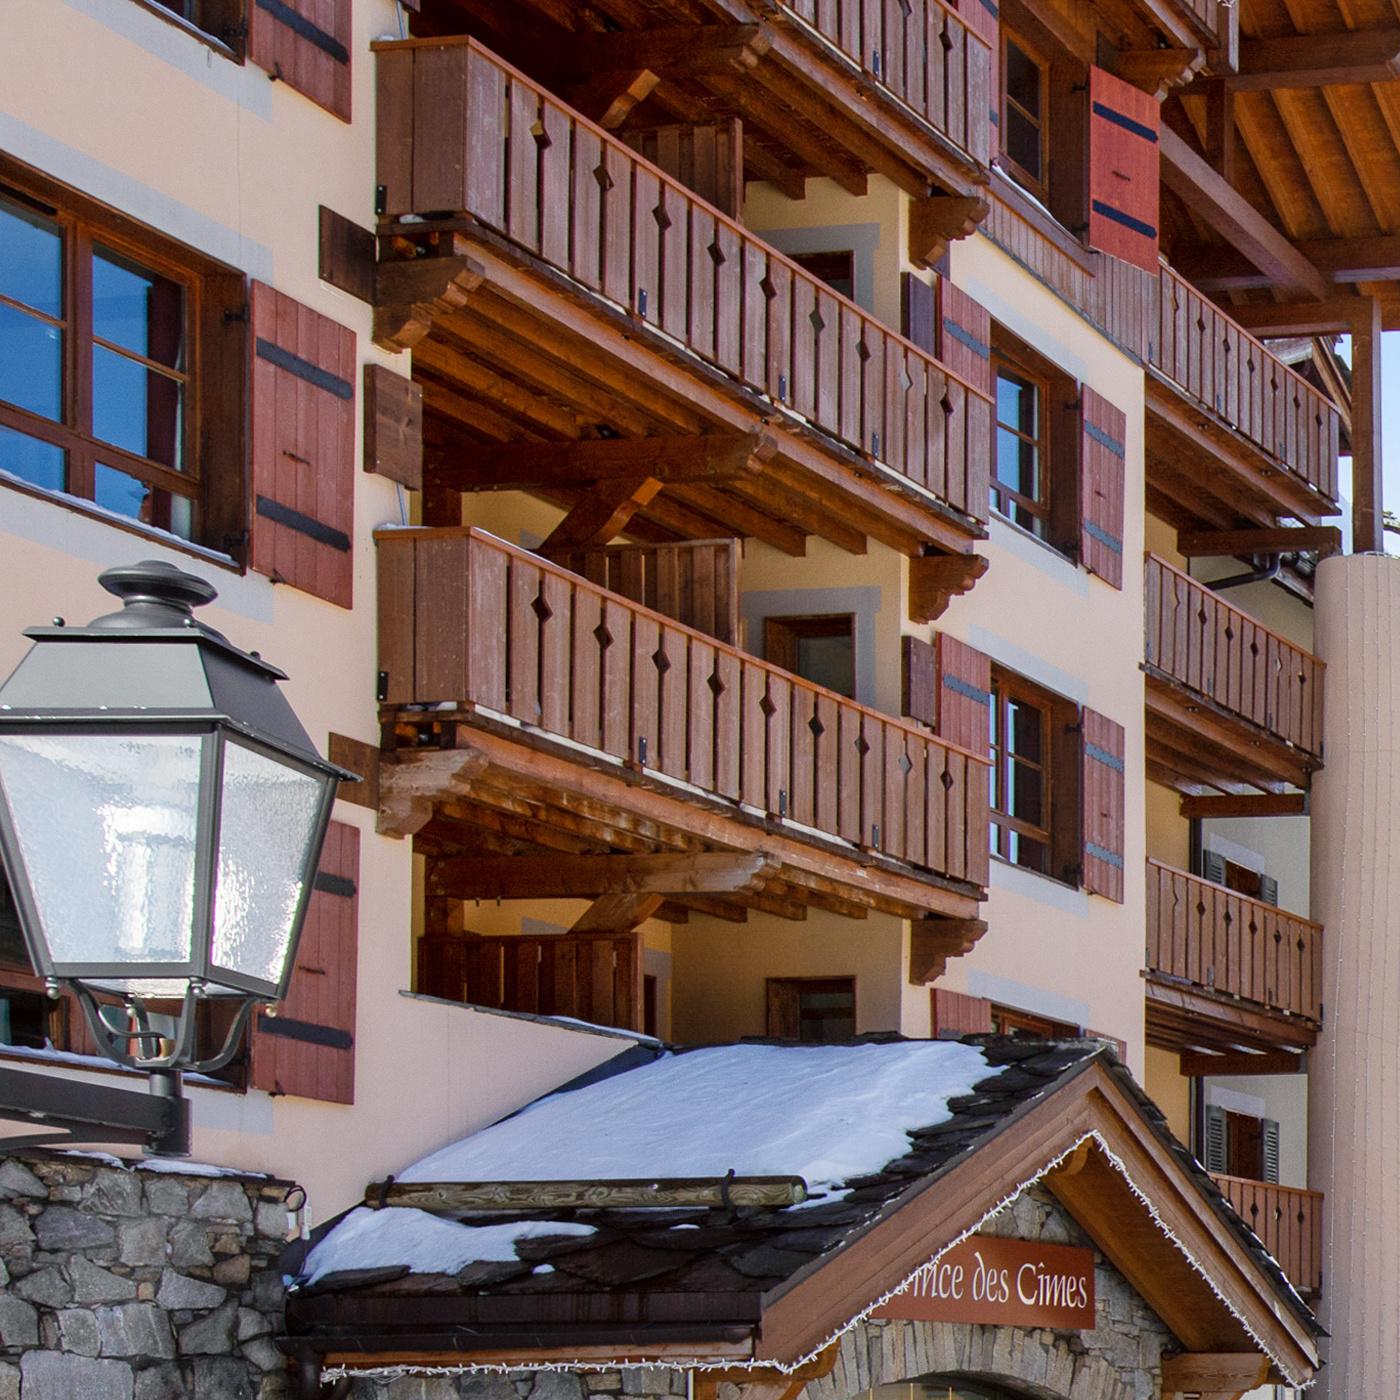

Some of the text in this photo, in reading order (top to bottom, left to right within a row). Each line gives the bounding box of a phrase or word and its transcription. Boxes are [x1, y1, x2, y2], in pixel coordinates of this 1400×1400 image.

[913, 1252, 1088, 1309] ince des Cîmes
